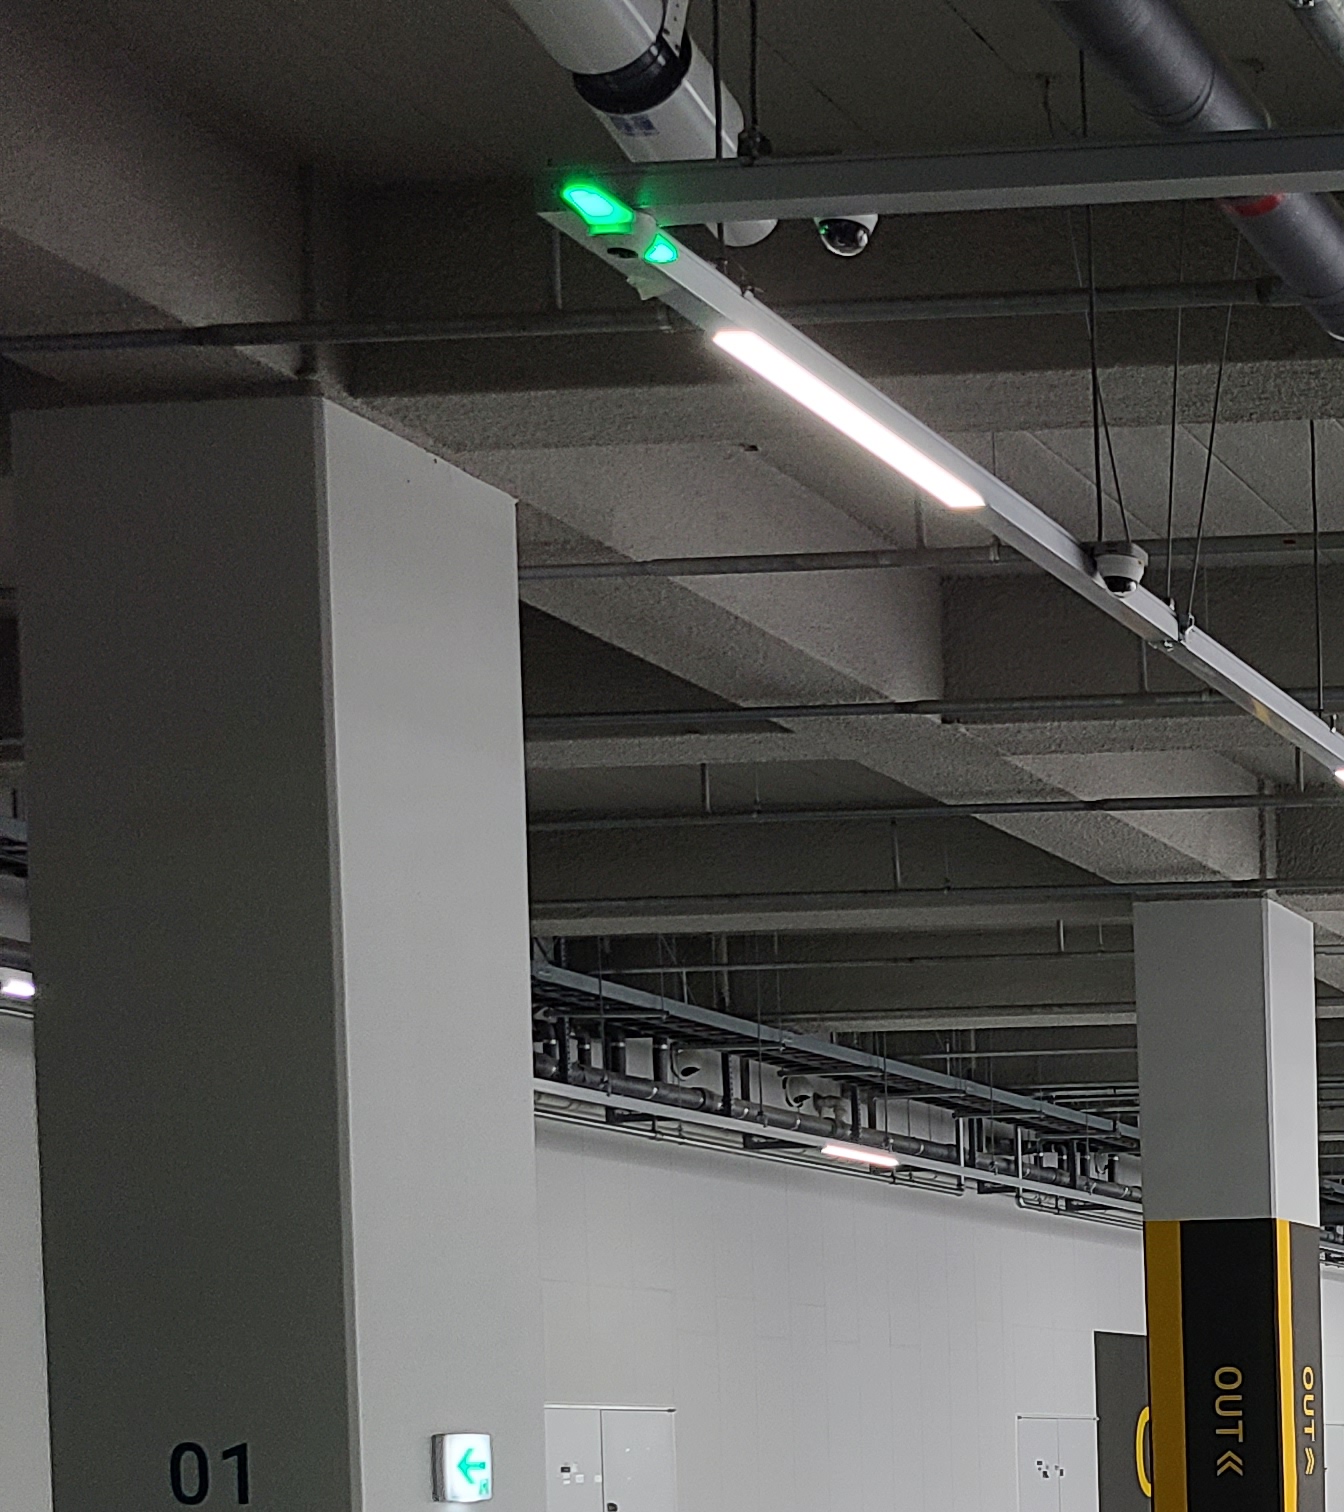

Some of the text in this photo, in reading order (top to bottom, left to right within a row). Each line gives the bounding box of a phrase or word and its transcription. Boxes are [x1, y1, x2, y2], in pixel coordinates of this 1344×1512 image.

[1214, 1366, 1244, 1443] OUT
[1302, 1366, 1316, 1442] OUT
[169, 1441, 251, 1506] 01
